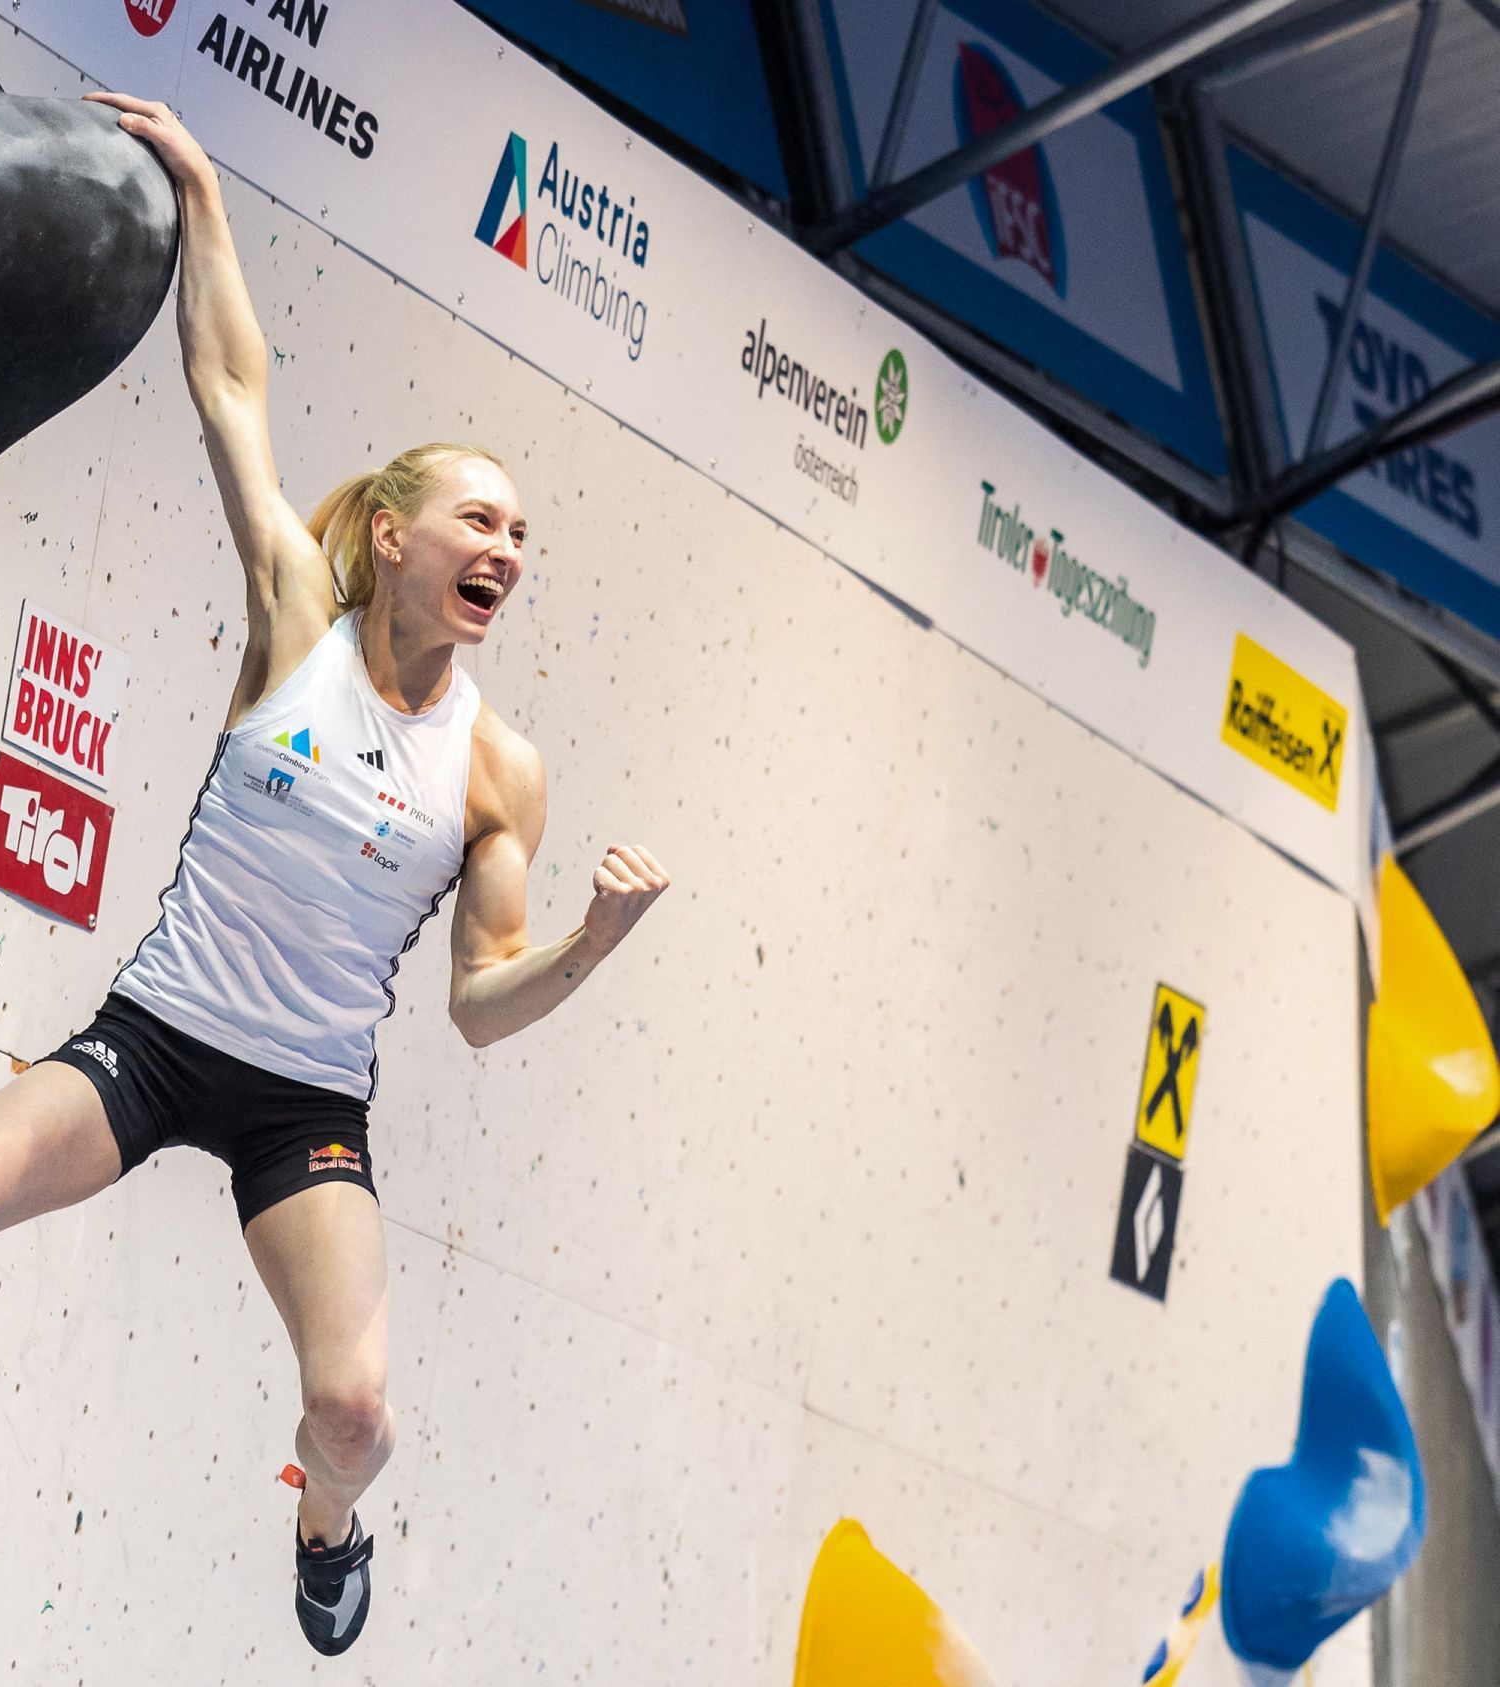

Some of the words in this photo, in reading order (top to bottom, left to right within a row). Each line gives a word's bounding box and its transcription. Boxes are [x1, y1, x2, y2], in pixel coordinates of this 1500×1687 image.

[131, 0, 164, 24] AL
[197, 13, 378, 160] AIRLINES
[538, 141, 649, 268] Austria
[536, 223, 647, 361] Climbing
[741, 318, 868, 450] alpenverein
[794, 433, 859, 507] österreich
[978, 480, 1034, 573] Tiroler
[1048, 528, 1156, 669] Tageszeitung
[23, 614, 102, 699] INNS'
[13, 678, 112, 776] BRUCK
[0, 785, 96, 895] Tirol
[374, 852, 400, 872] lapis
[409, 808, 434, 828] PRVA
[72, 1043, 119, 1078] adidas
[309, 1157, 337, 1173] Red
[338, 1157, 362, 1173] Bull
